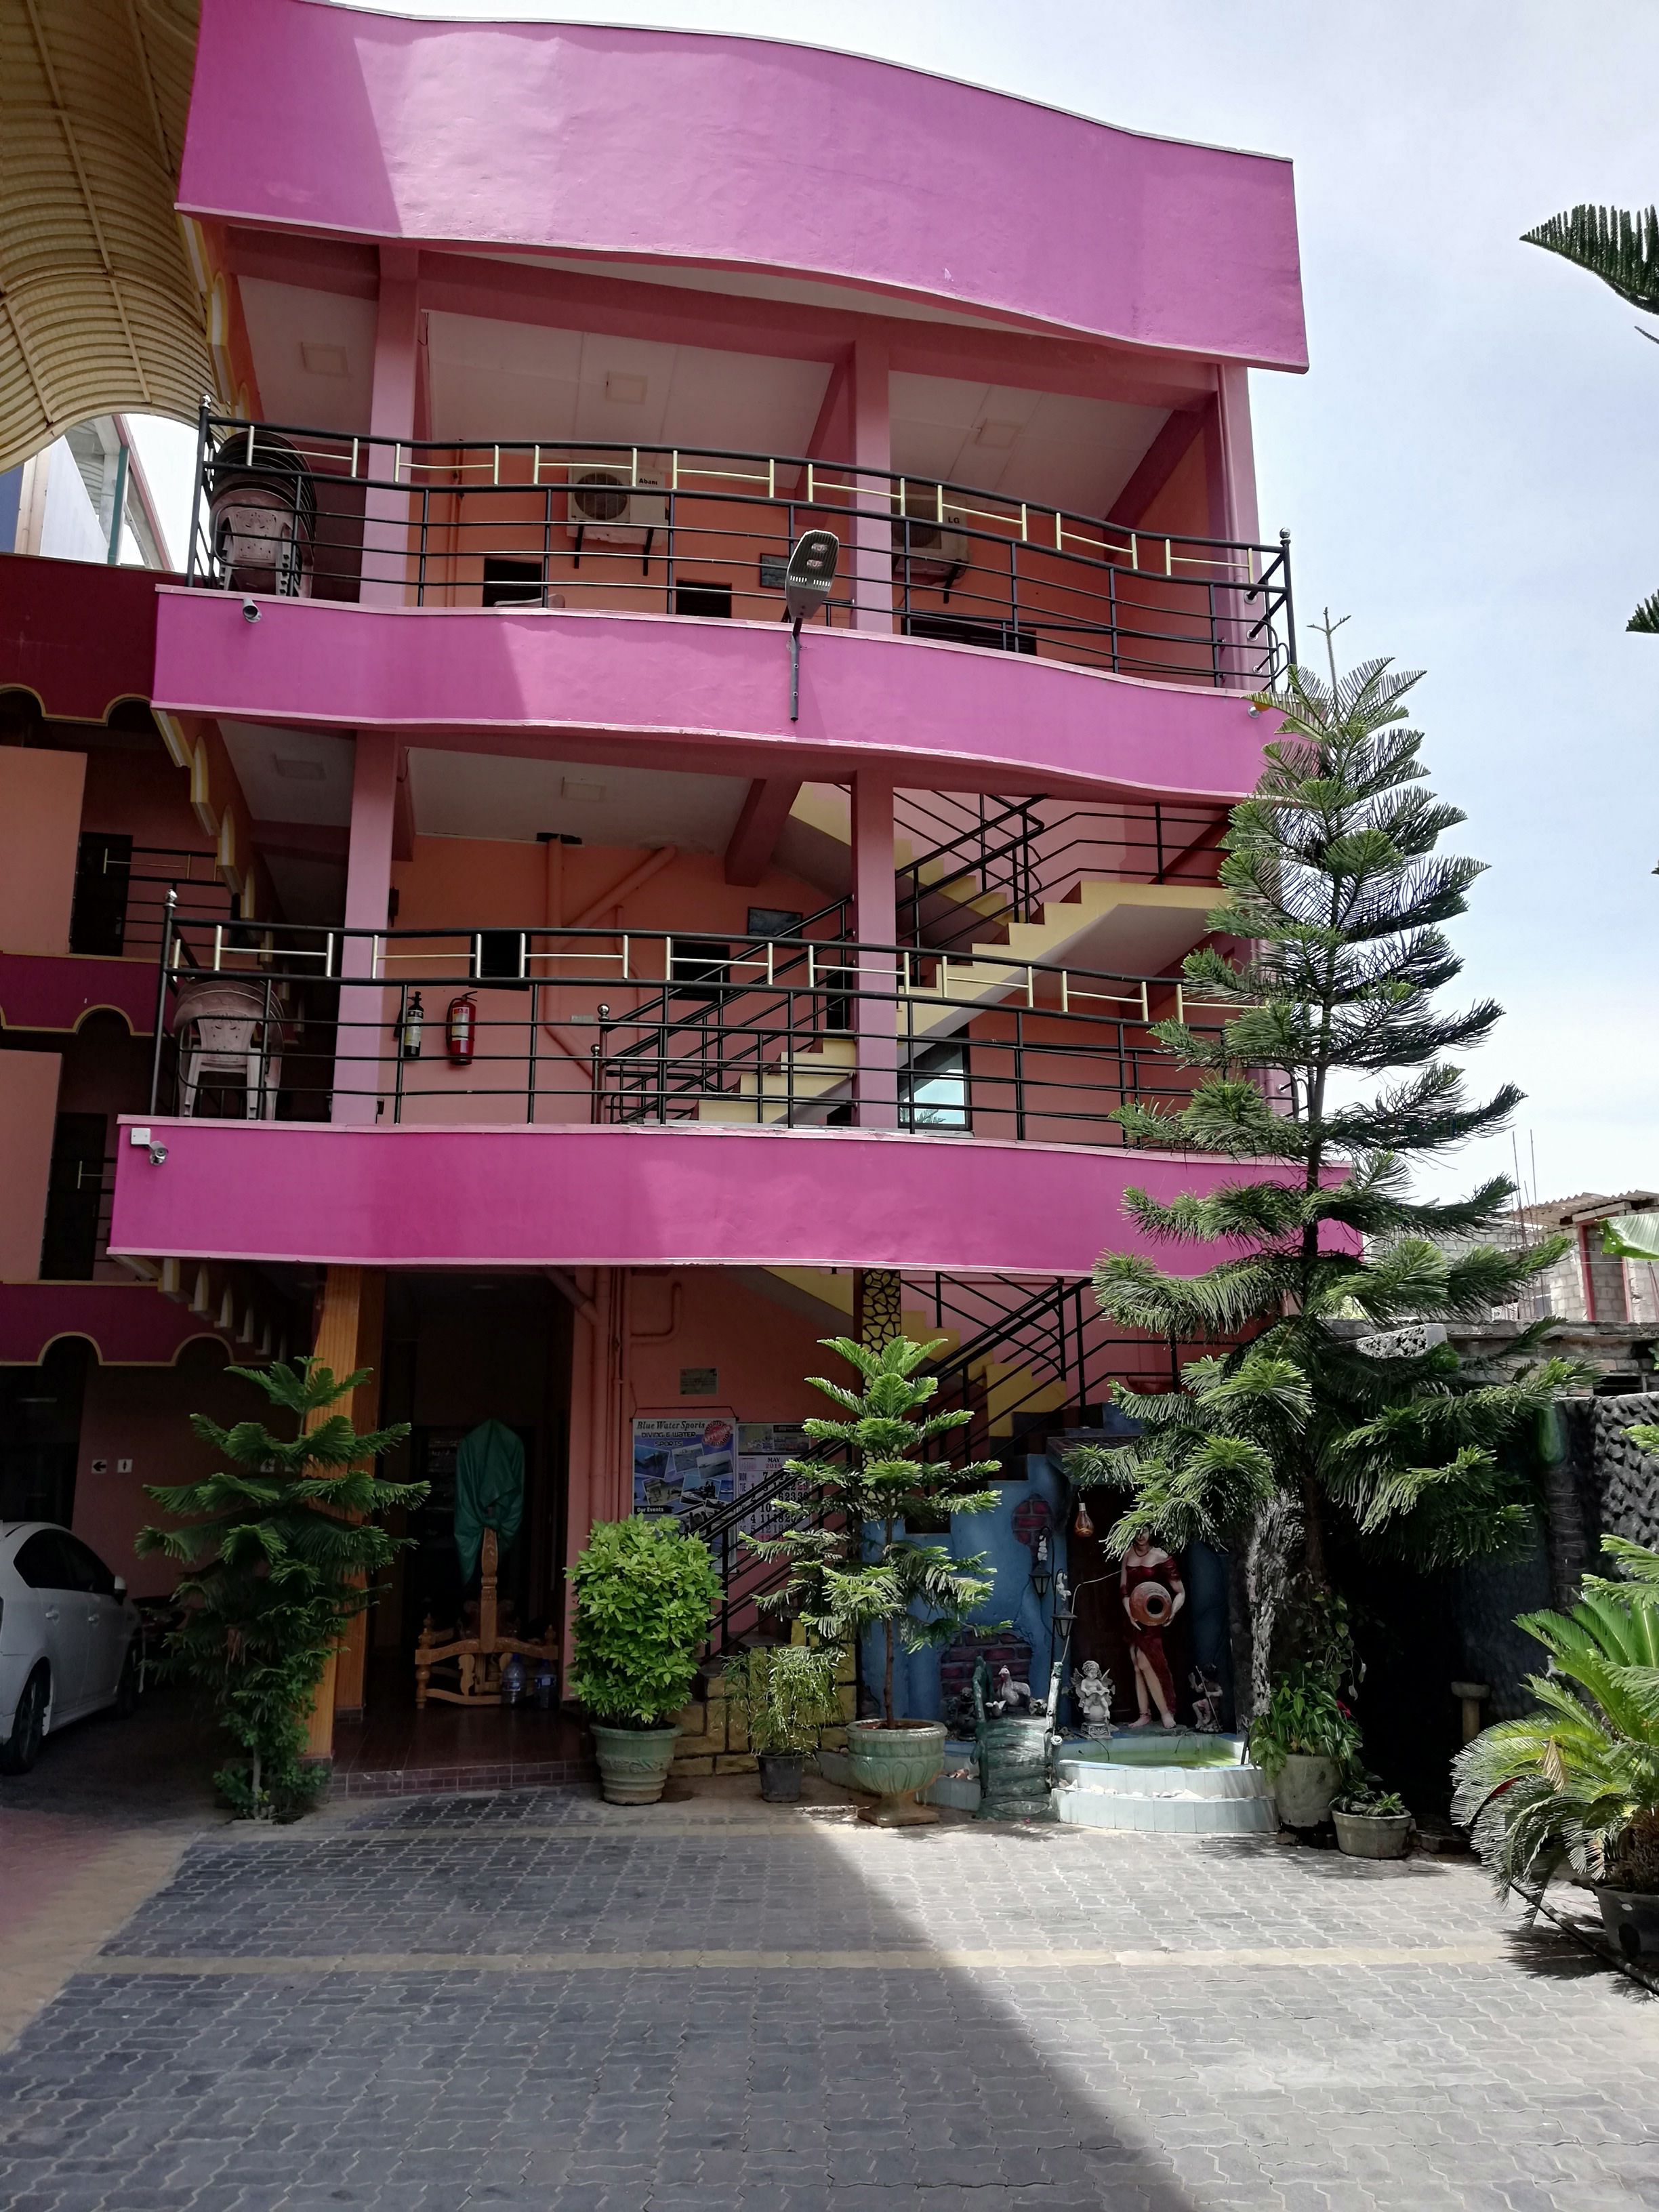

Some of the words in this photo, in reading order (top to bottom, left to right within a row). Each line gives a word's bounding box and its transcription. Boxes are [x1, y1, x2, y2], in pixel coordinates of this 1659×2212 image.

[637, 1421, 655, 1429] Blue
[657, 1421, 680, 1429] Water
[681, 1420, 705, 1431] Sports
[785, 1492, 796, 1501] 23
[760, 1503, 771, 1513] 10
[750, 1514, 756, 1523] 4
